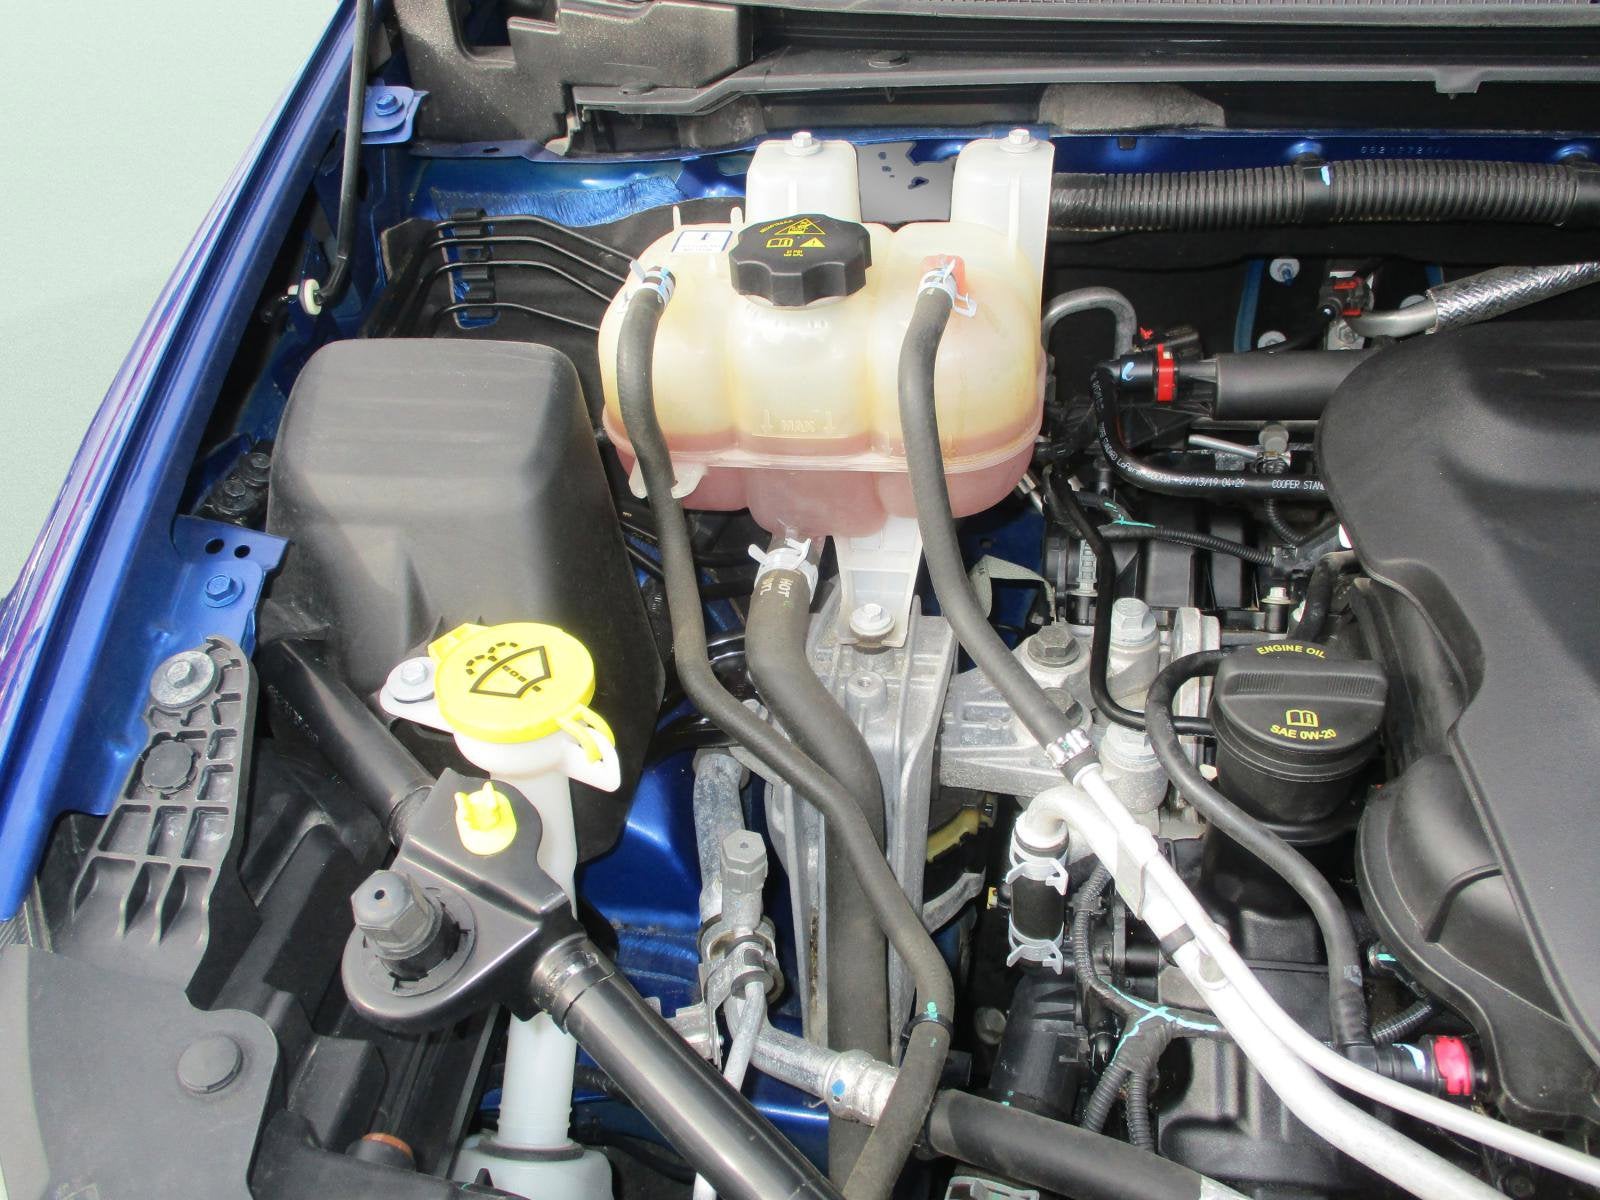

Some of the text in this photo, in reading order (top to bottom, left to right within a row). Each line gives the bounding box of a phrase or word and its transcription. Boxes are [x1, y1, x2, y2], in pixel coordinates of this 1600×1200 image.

[1271, 479, 1300, 489] COOPER
[778, 578, 793, 598] HOT
[1256, 644, 1326, 658] ENGINE OIL
[1270, 724, 1337, 740] SAE 0W-20
